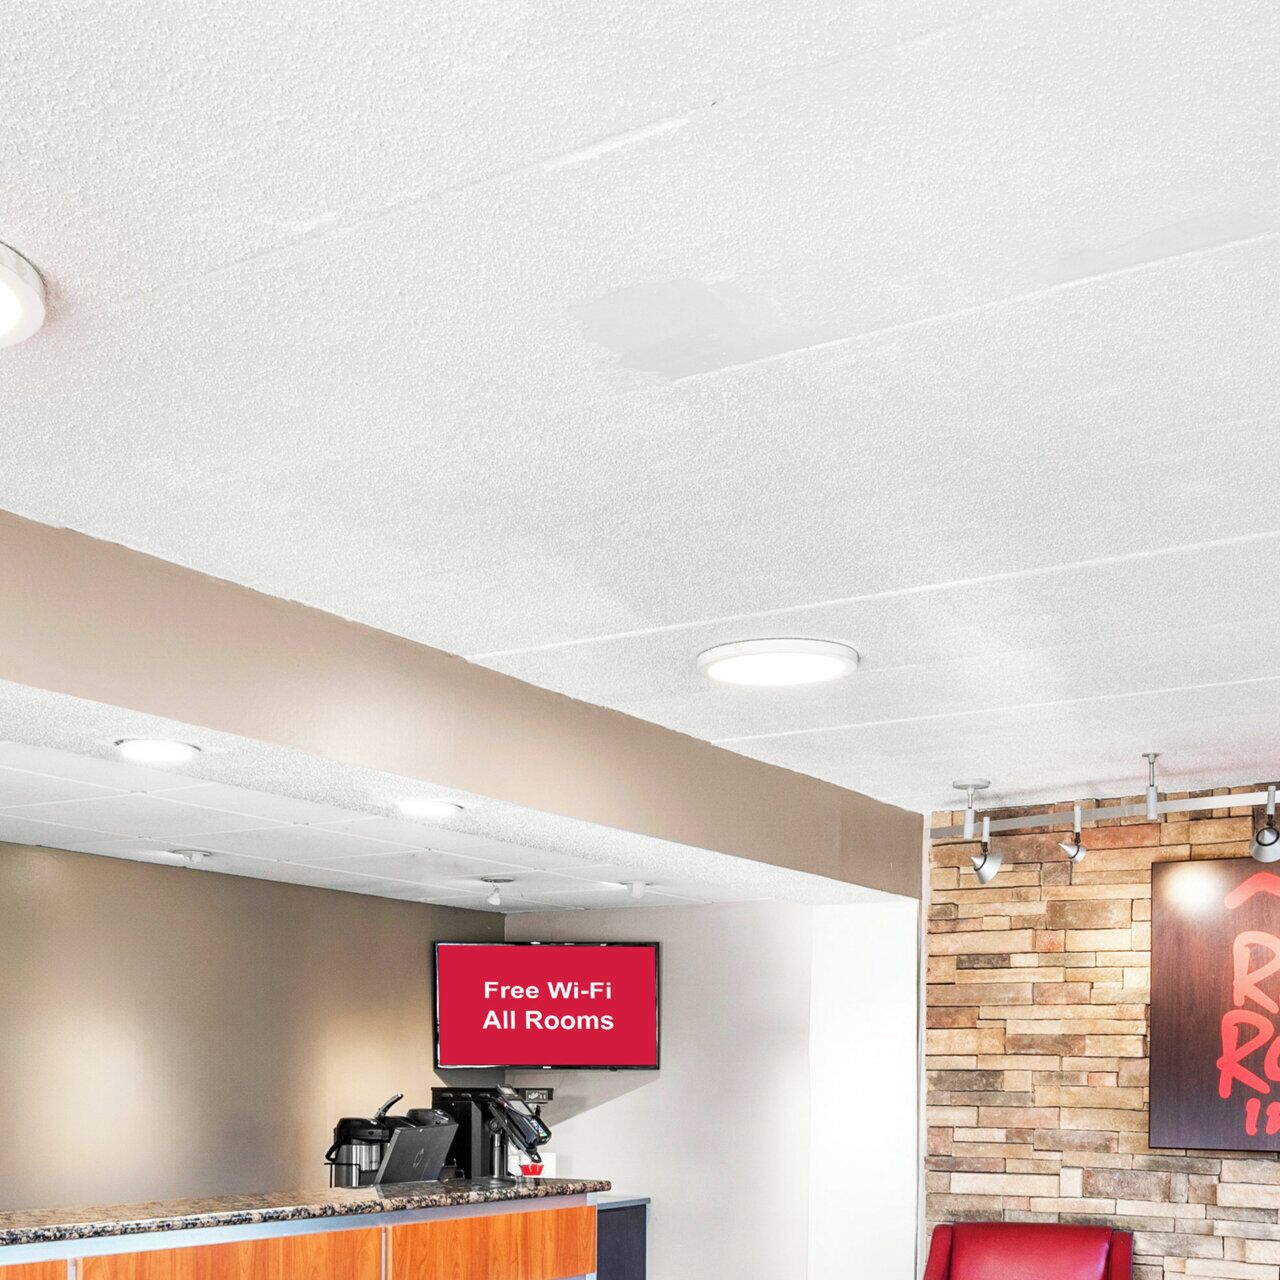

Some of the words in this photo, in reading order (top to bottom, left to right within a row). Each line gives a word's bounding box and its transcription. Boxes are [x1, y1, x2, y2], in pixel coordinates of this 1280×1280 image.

[484, 981, 540, 999] Free
[547, 981, 612, 999] Wi-Fi
[482, 1010, 516, 1030] All
[525, 1010, 614, 1030] Rooms
